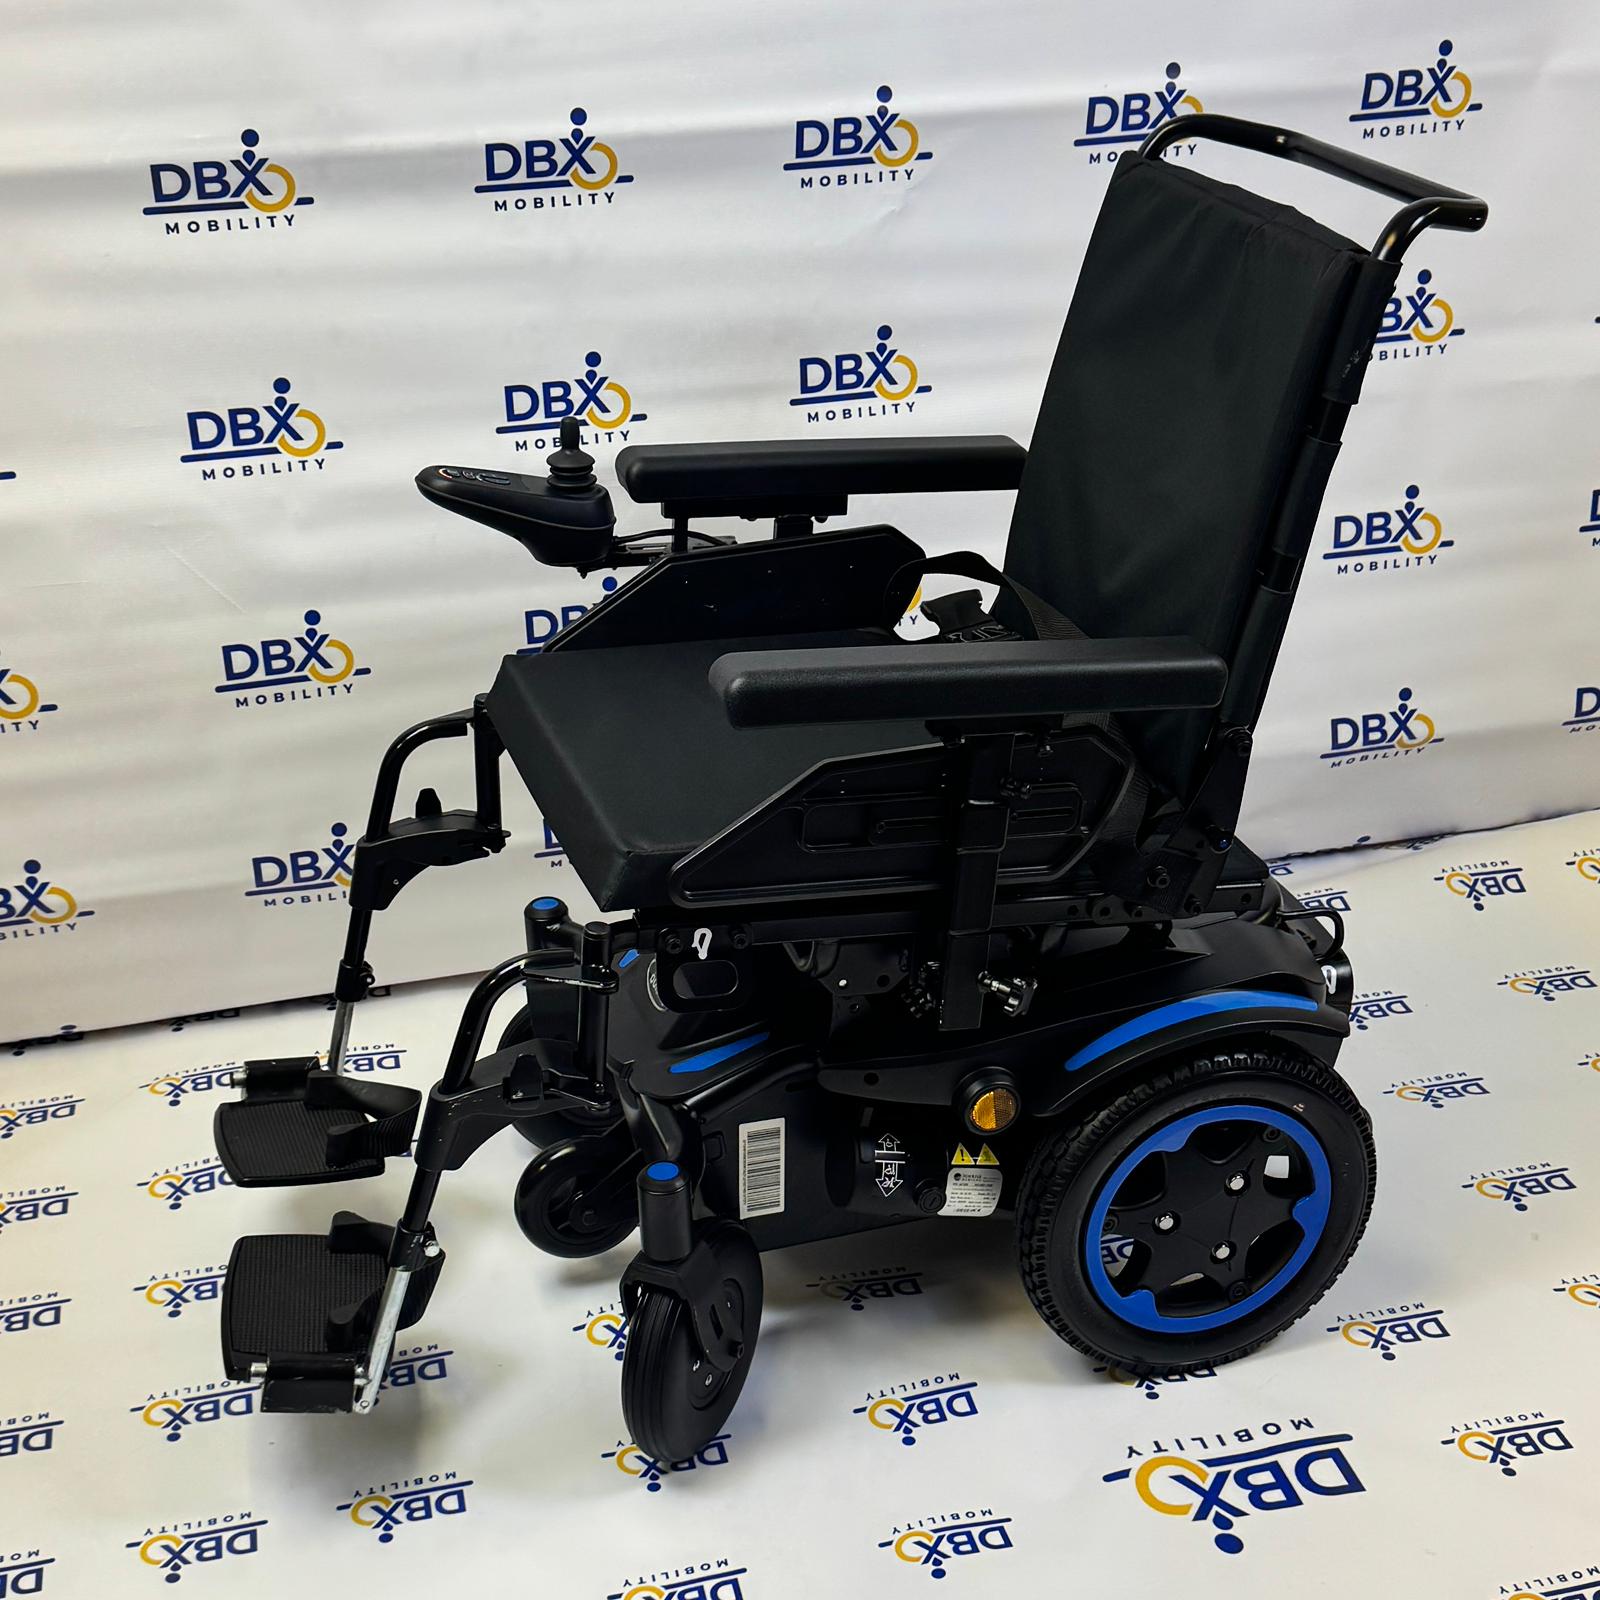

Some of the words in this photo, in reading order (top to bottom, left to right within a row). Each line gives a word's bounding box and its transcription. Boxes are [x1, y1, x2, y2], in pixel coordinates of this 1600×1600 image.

[1360, 65, 1457, 111] DBX
[1086, 89, 1187, 135] DBX
[795, 113, 900, 160] DBX
[1363, 119, 1466, 140] MOBILITY
[485, 136, 597, 181] DBX
[1089, 144, 1198, 164] MOITY
[150, 158, 273, 203] DBX
[800, 168, 914, 189] MOBILITY
[494, 191, 615, 211] MOBILITY
[165, 214, 297, 235] MOBILITY
[1380, 293, 1437, 332] BX
[1369, 343, 1447, 361] BILITY
[800, 348, 899, 394] DBX
[504, 376, 610, 422] DBX
[807, 401, 915, 423] MOBILITY
[187, 404, 304, 450] DBX
[515, 430, 630, 451] MOBLITY
[202, 458, 326, 481] MOBILITY
[1333, 507, 1423, 548] DBX
[1337, 555, 1438, 575] MOBILITY
[222, 634, 334, 682] DBX
[236, 683, 354, 708] MOBILITY
[1331, 709, 1417, 750] DBX
[1330, 747, 1425, 768] MOBILITY
[252, 844, 355, 888] DBX
[1442, 860, 1510, 873] MOBILITY
[264, 891, 347, 907] MOBILI
[1458, 874, 1526, 898] DBX
[0, 922, 77, 940] BILITY
[1504, 965, 1576, 979] MOBILITY
[1520, 975, 1598, 994] DBX
[1391, 1072, 1467, 1087] MOBILITY
[1410, 1082, 1490, 1102] DBX
[1470, 1162, 1551, 1180] MOBILITY
[1491, 1173, 1577, 1200] DBX
[149, 1265, 228, 1281] OBILITY
[163, 1281, 218, 1307] BX
[836, 1278, 923, 1301] DBX
[1337, 1302, 1425, 1322] MOBILITY
[1358, 1317, 1450, 1348] DBX
[866, 1372, 960, 1400] MOBILITY
[161, 1393, 253, 1429] DBX
[886, 1391, 979, 1432] DBX
[1451, 1411, 1544, 1433] MOBILITY
[1127, 1417, 1314, 1459] MOBILITY
[1474, 1424, 1574, 1463] DBX
[354, 1471, 456, 1498] MOBILITY
[1168, 1447, 1366, 1521] DBX
[370, 1489, 467, 1529] DBX
[892, 1508, 993, 1534] MOBILITY
[144, 1511, 252, 1535] MOBILITY
[159, 1528, 258, 1568] DBX
[912, 1525, 1014, 1564] DBX
[623, 1558, 728, 1588] MOBILITY
